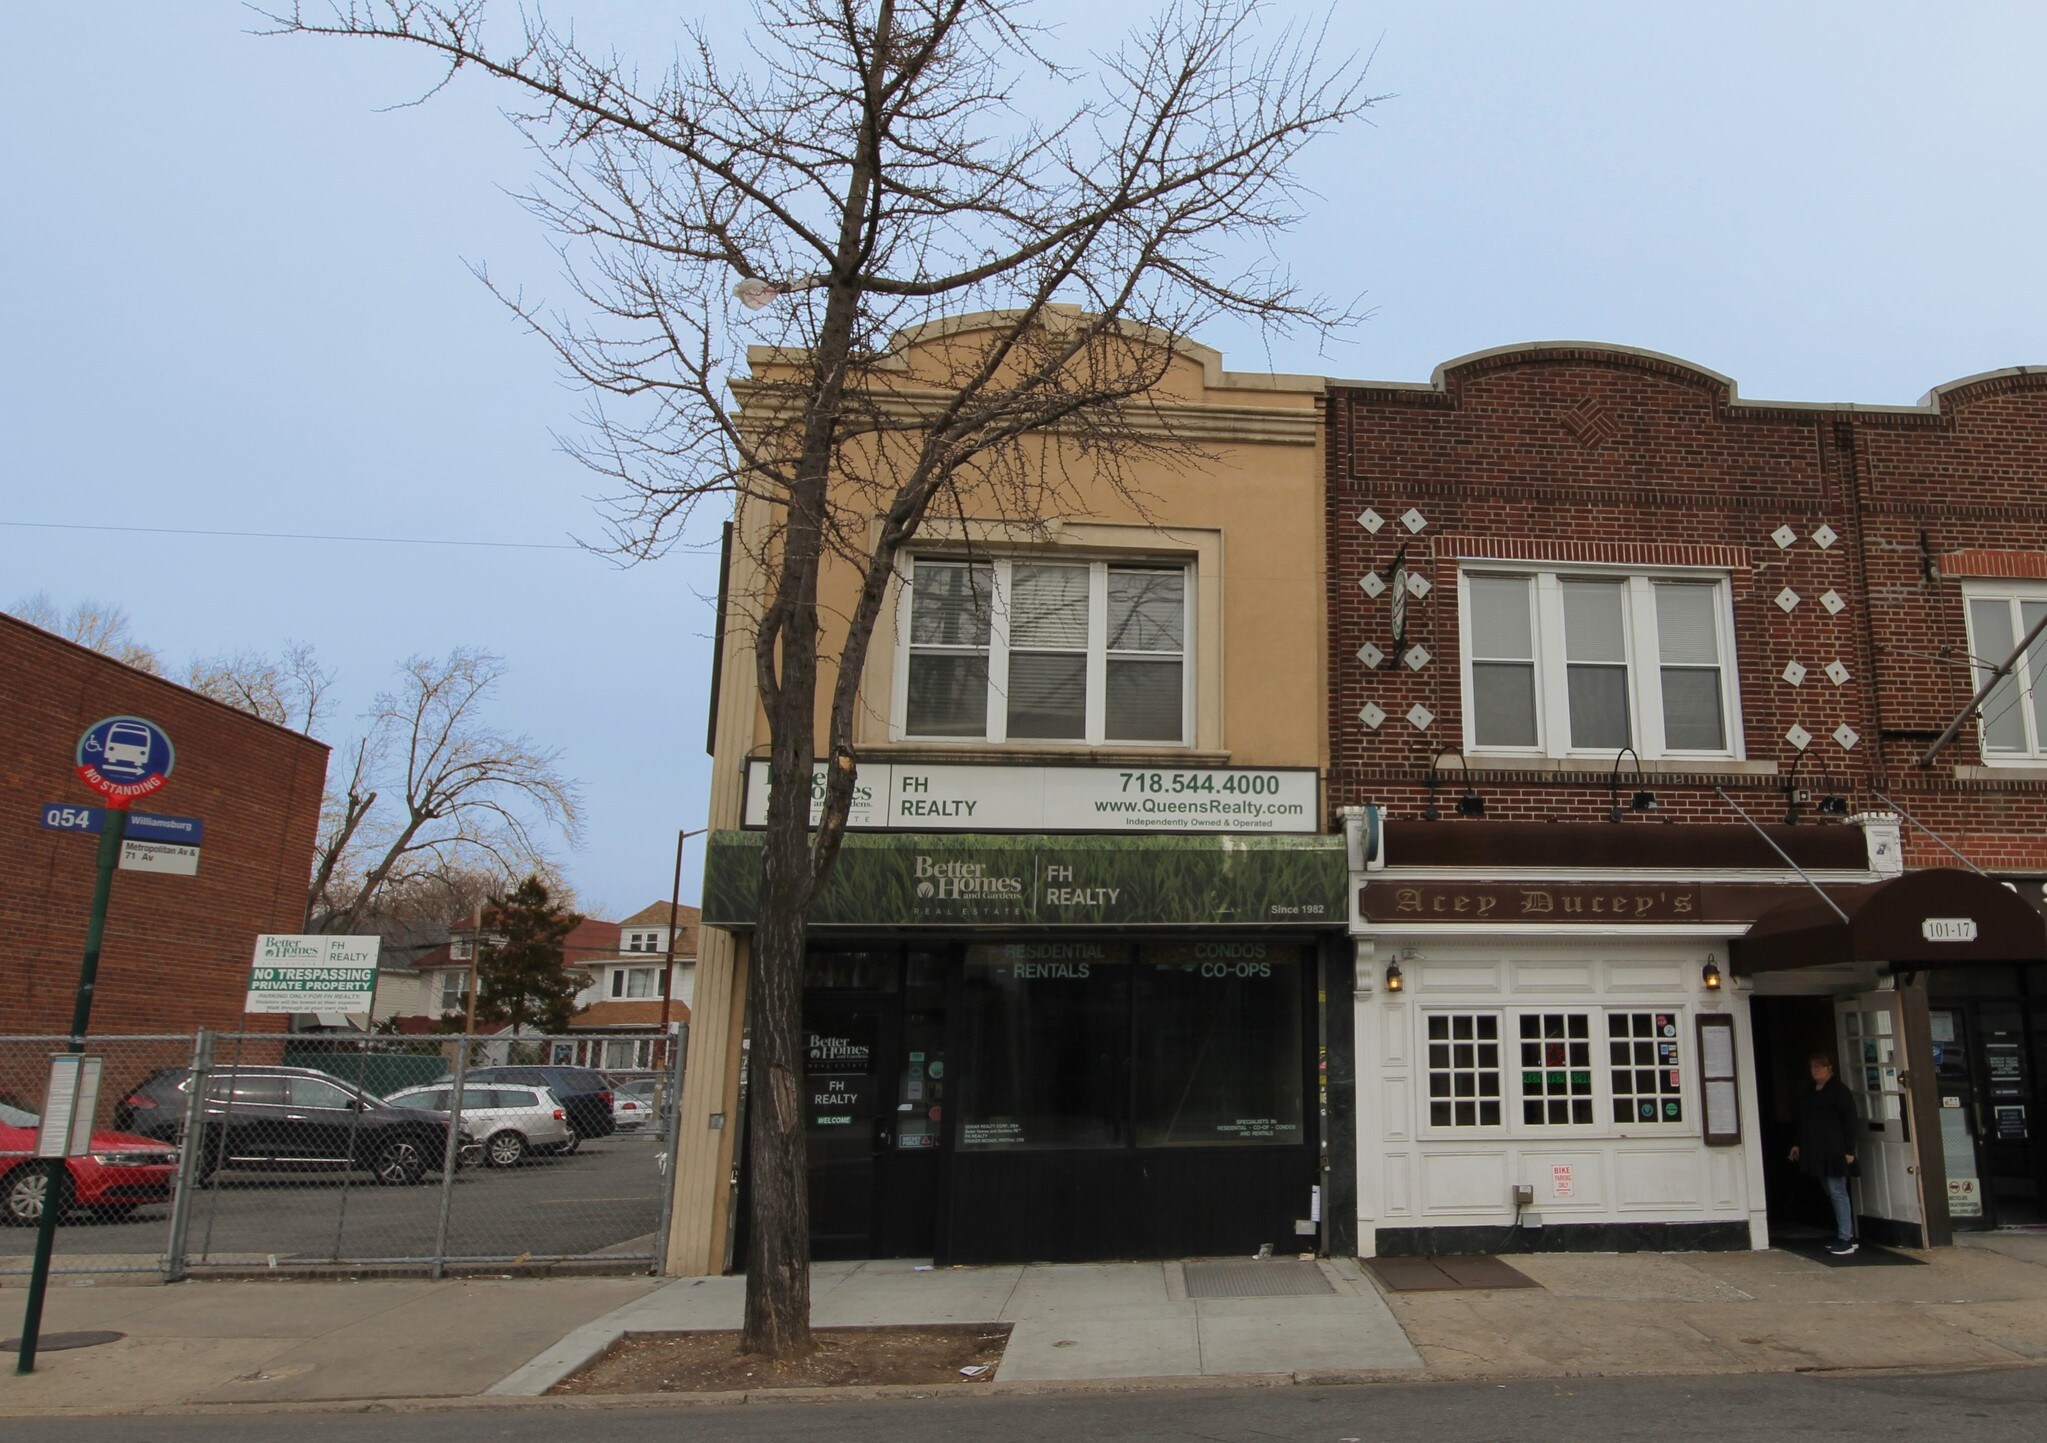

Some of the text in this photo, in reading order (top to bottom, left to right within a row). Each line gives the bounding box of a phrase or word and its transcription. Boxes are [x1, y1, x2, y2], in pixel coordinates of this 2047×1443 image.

[84, 768, 161, 795] NO STANDING
[902, 777, 928, 793] FH
[1119, 773, 1280, 795] 718.544.4000
[900, 800, 977, 816] REALTY
[1094, 799, 1303, 817] www.QueensRealty.com
[47, 808, 90, 829] Q54
[131, 816, 192, 832] Williamsburg
[1126, 818, 1273, 828] Independently Owned & Operated
[126, 842, 176, 855] Metropolitan
[141, 853, 154, 861] Av
[914, 856, 986, 878] Better
[1047, 866, 1072, 882] FH
[936, 877, 1022, 899] Homes
[1047, 889, 1120, 905] REALTY
[1395, 888, 1693, 917] Acey Ducey's
[1271, 904, 1324, 914] Since 1982
[1929, 922, 1970, 937] 101-17
[265, 937, 301, 947] Better
[275, 946, 318, 958] Homes
[330, 953, 368, 961] REALTY
[1007, 944, 1106, 958] RESIDENTIAL
[1195, 943, 1266, 958] CONDOS
[254, 969, 371, 980] NO TRESPASSING
[1014, 963, 1090, 978] RENTALS
[1201, 962, 1271, 977] CO-OPS
[251, 981, 370, 990] PRIVATE PROPERTY
[810, 1035, 850, 1047] Better
[822, 1046, 869, 1059] Homes
[829, 1081, 844, 1091] FH
[815, 1094, 858, 1105] REALTY
[817, 1116, 851, 1124] WELCOME
